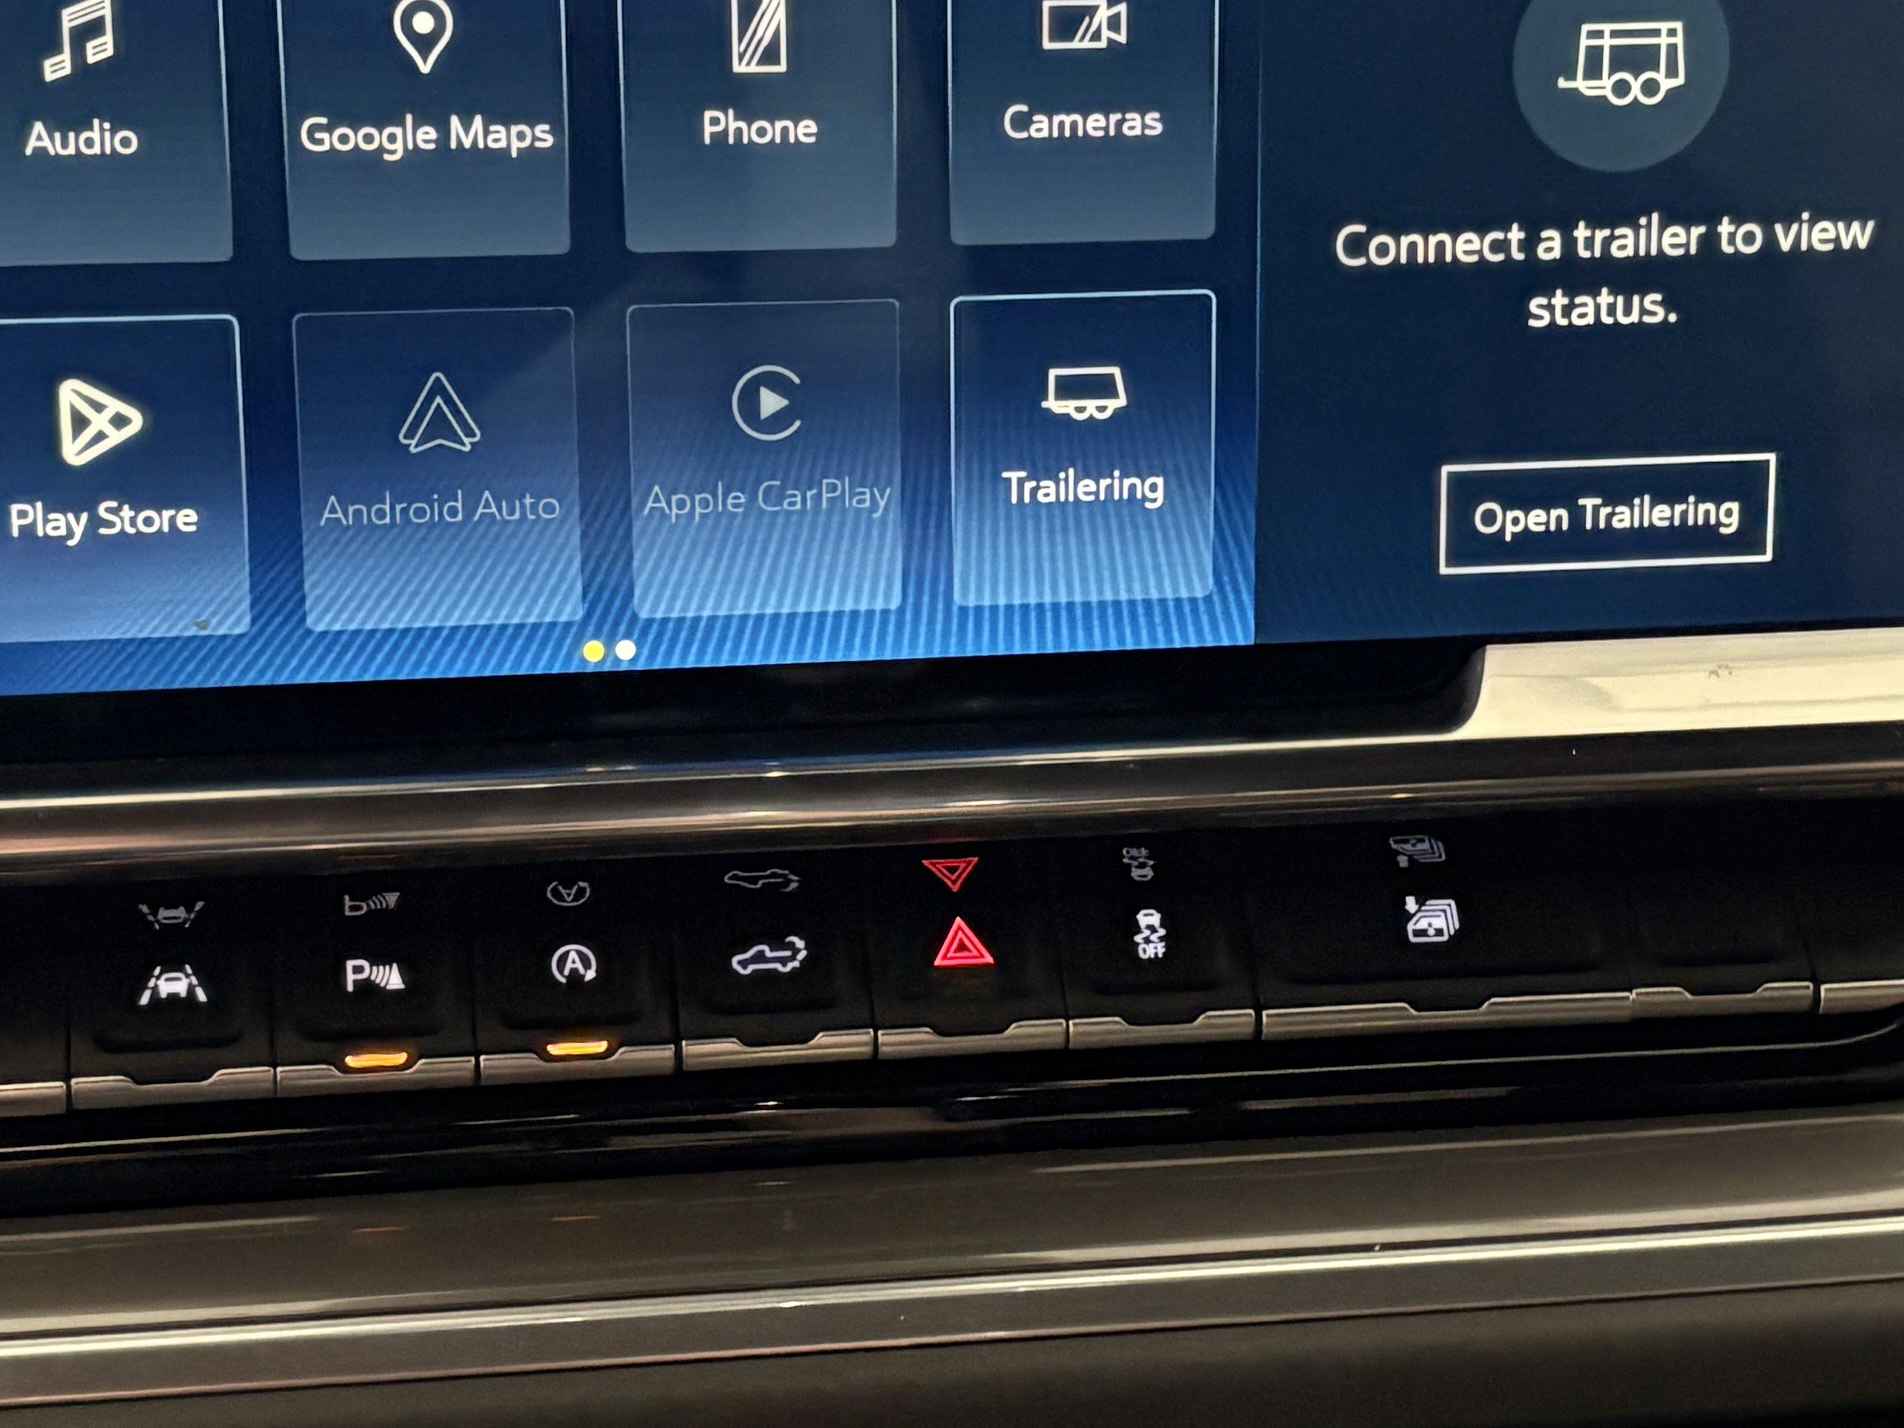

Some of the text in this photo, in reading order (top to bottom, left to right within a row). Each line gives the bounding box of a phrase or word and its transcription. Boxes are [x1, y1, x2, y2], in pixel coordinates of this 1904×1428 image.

[24, 118, 139, 156] Audio
[300, 113, 554, 162] Google Maps
[703, 108, 818, 145] Phone
[1003, 104, 1164, 139] Cameras
[1335, 211, 1875, 267] Connect a trailer to view
[1527, 286, 1678, 328] status.
[319, 489, 561, 528] Android Auto
[642, 477, 892, 518] Apple CarPlay
[1001, 467, 1165, 510] Trailering
[9, 500, 199, 547] Play Store
[1474, 494, 1740, 542] Open Trailering
[1137, 942, 1166, 959] OFF
